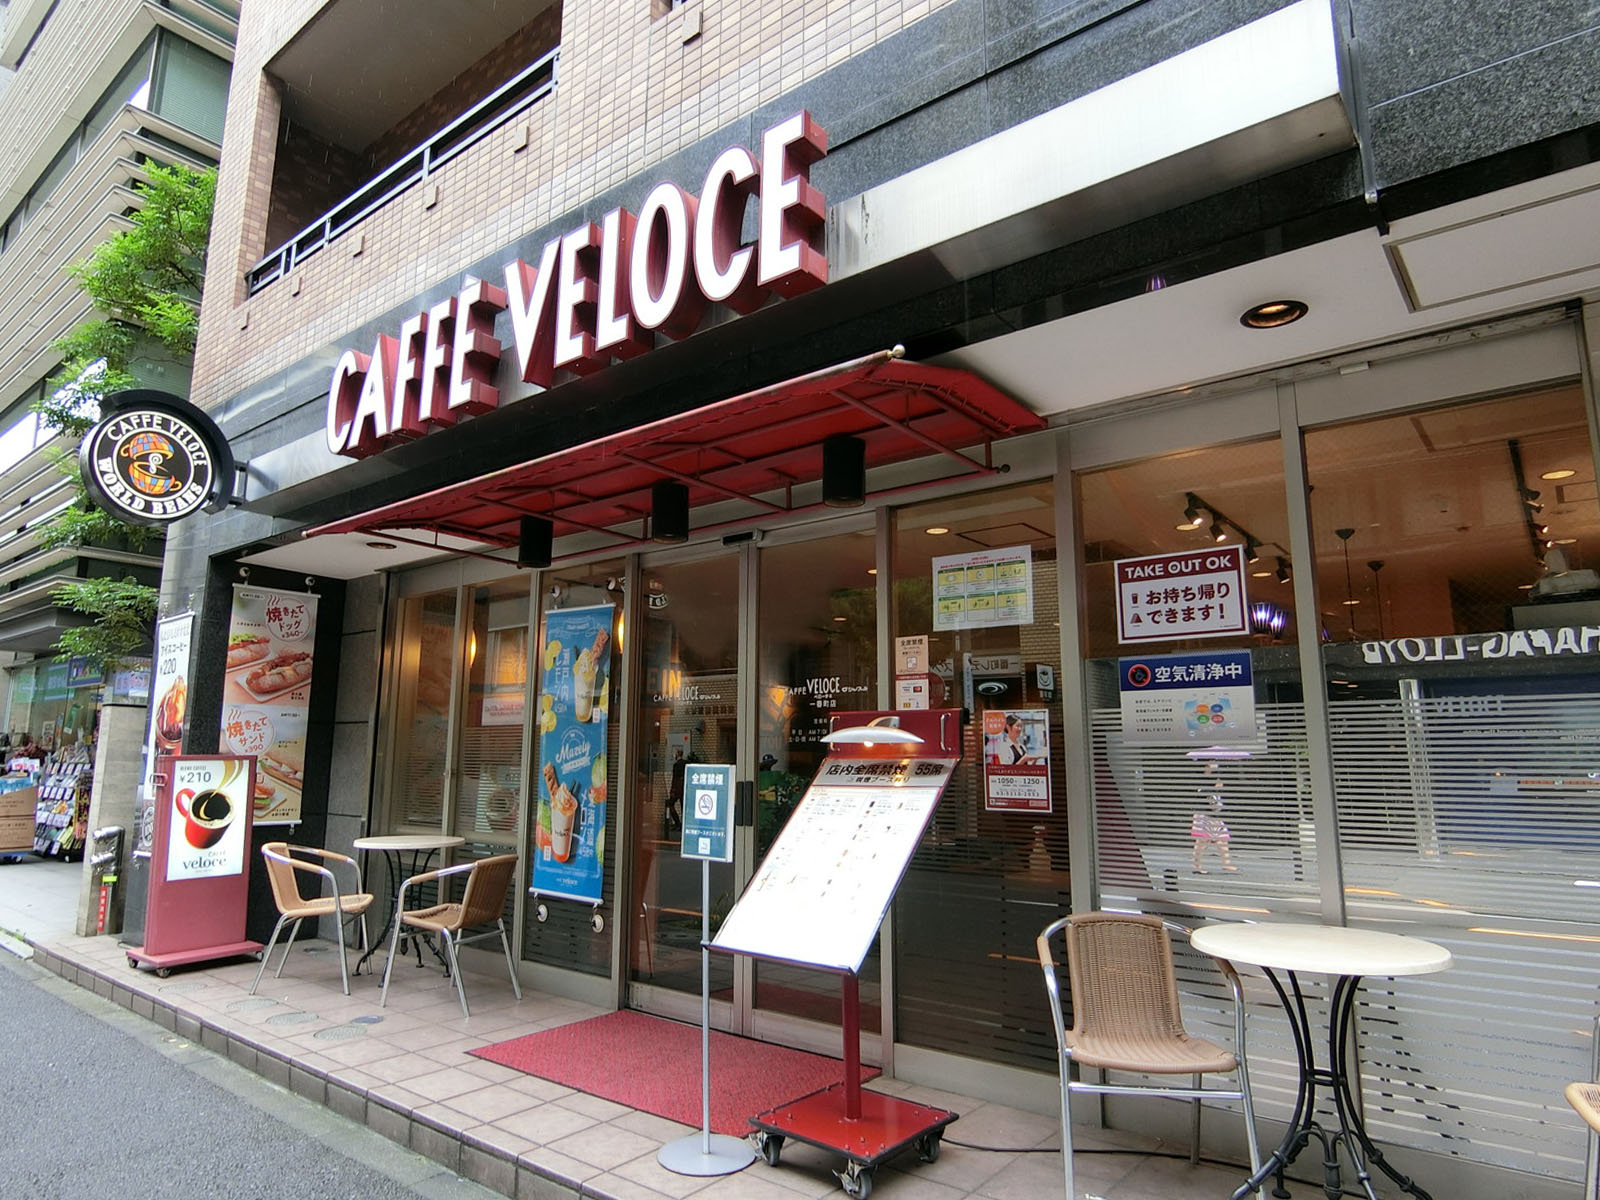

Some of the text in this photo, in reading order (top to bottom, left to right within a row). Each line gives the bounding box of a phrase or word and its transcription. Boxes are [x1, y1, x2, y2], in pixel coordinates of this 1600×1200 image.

[504, 110, 815, 385] VELOCE
[170, 420, 207, 467] VELOCE
[98, 456, 204, 514] WORLD BEANS
[1125, 555, 1232, 579] TAKE OUT OK
[1145, 582, 1230, 606] お持ち帰り
[266, 604, 305, 623] 焼きたて
[279, 619, 302, 632] ドッグ
[1154, 662, 1243, 683] 空気清浄中
[806, 677, 840, 694] VELOCE
[227, 716, 268, 739] 焼きたて
[238, 732, 265, 747] サンド
[180, 770, 212, 783] ¥210
[915, 763, 944, 776] 55席
[183, 857, 227, 869] veloce
